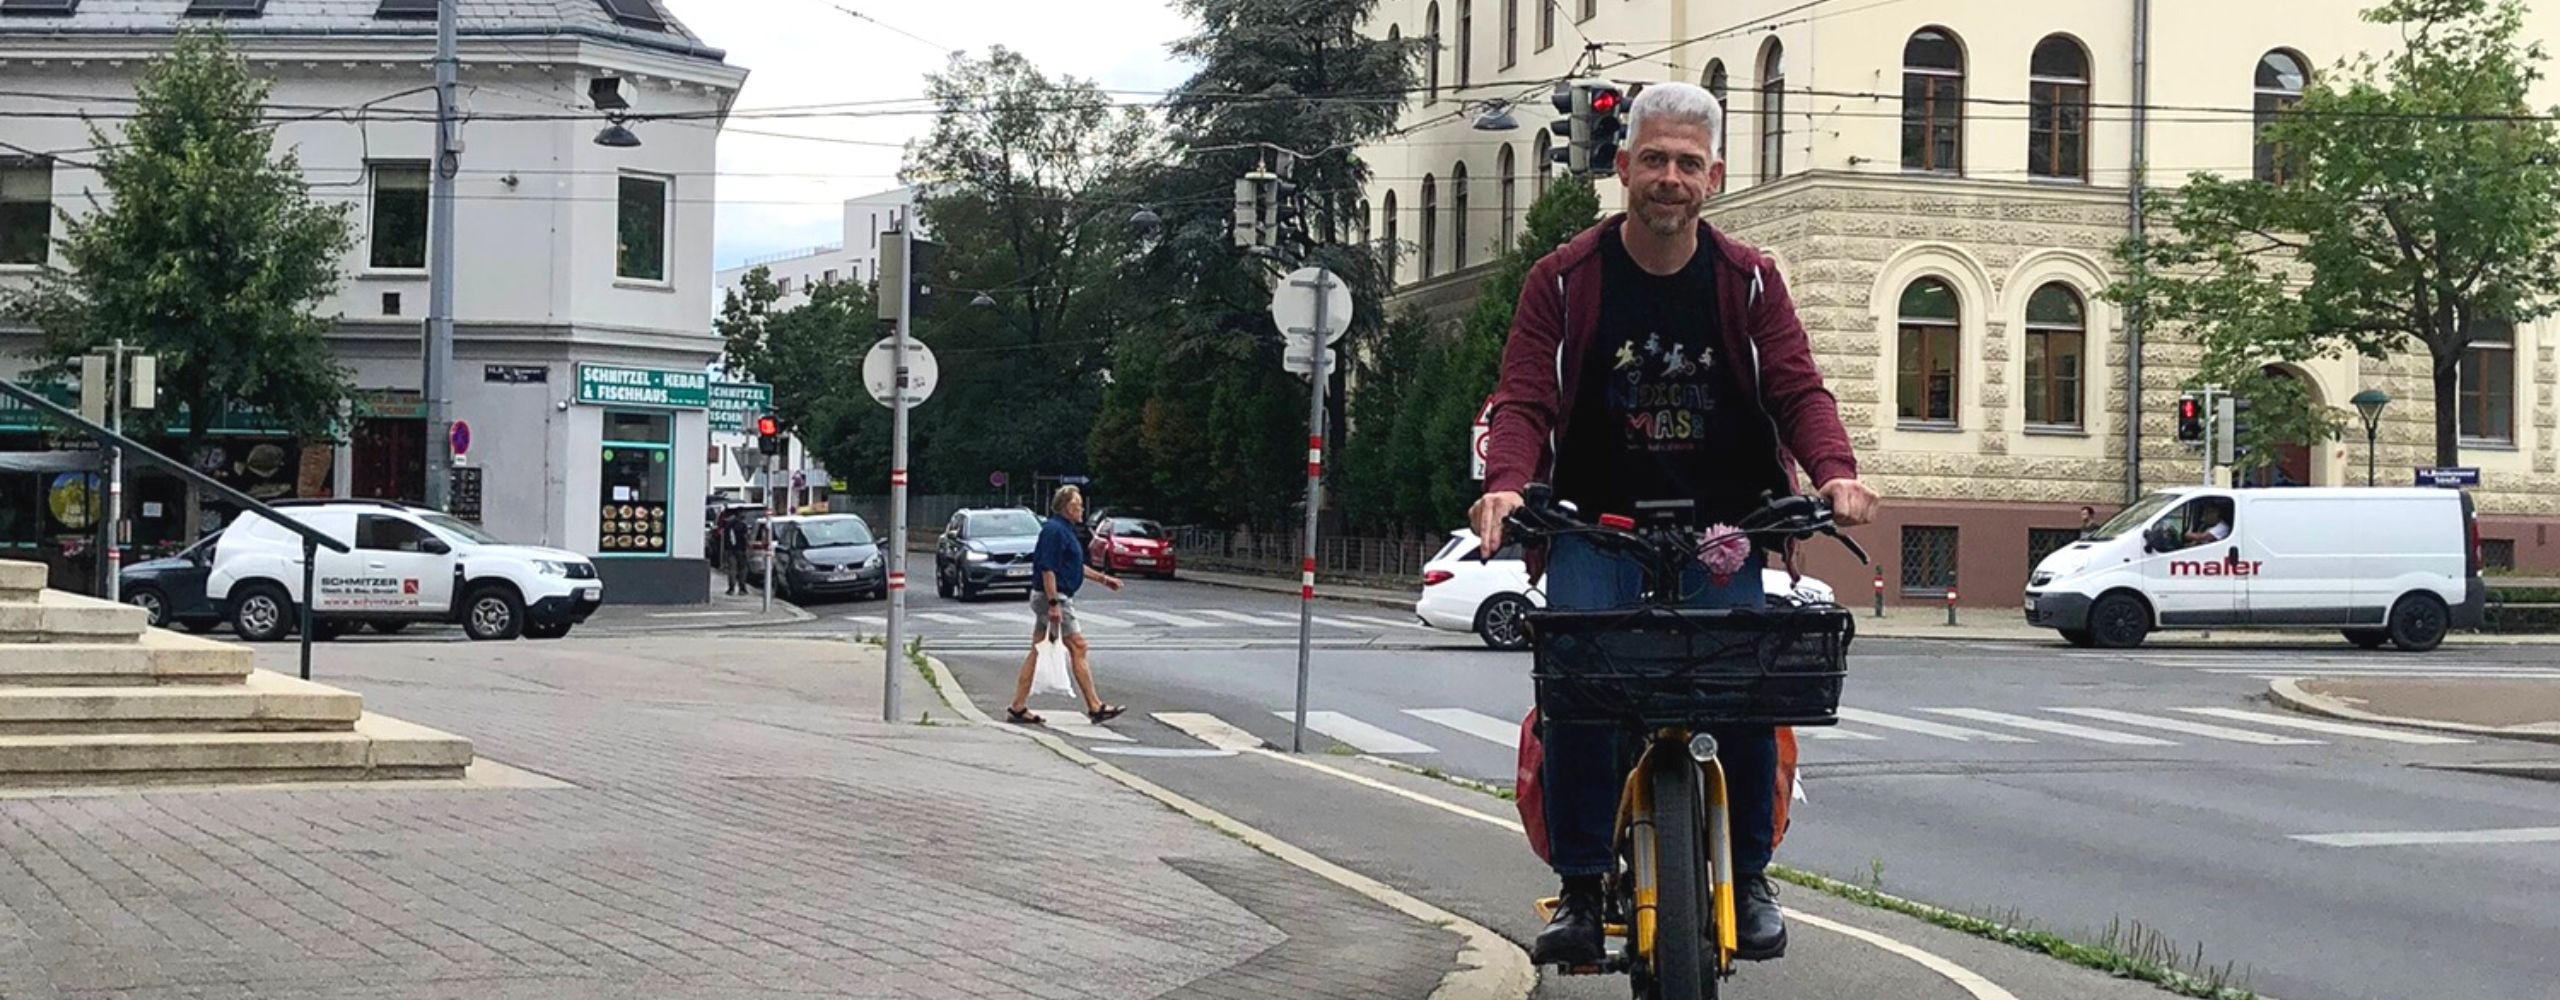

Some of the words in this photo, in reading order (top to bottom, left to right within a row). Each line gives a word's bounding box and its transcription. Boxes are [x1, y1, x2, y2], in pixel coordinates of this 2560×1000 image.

[583, 367, 651, 385] SCHNITZEL
[663, 373, 706, 389] KEBAB
[583, 386, 593, 399] &
[598, 386, 668, 403] FISCHHAUS
[2170, 556, 2263, 576] maler
[321, 577, 398, 586] SCHMITZER
